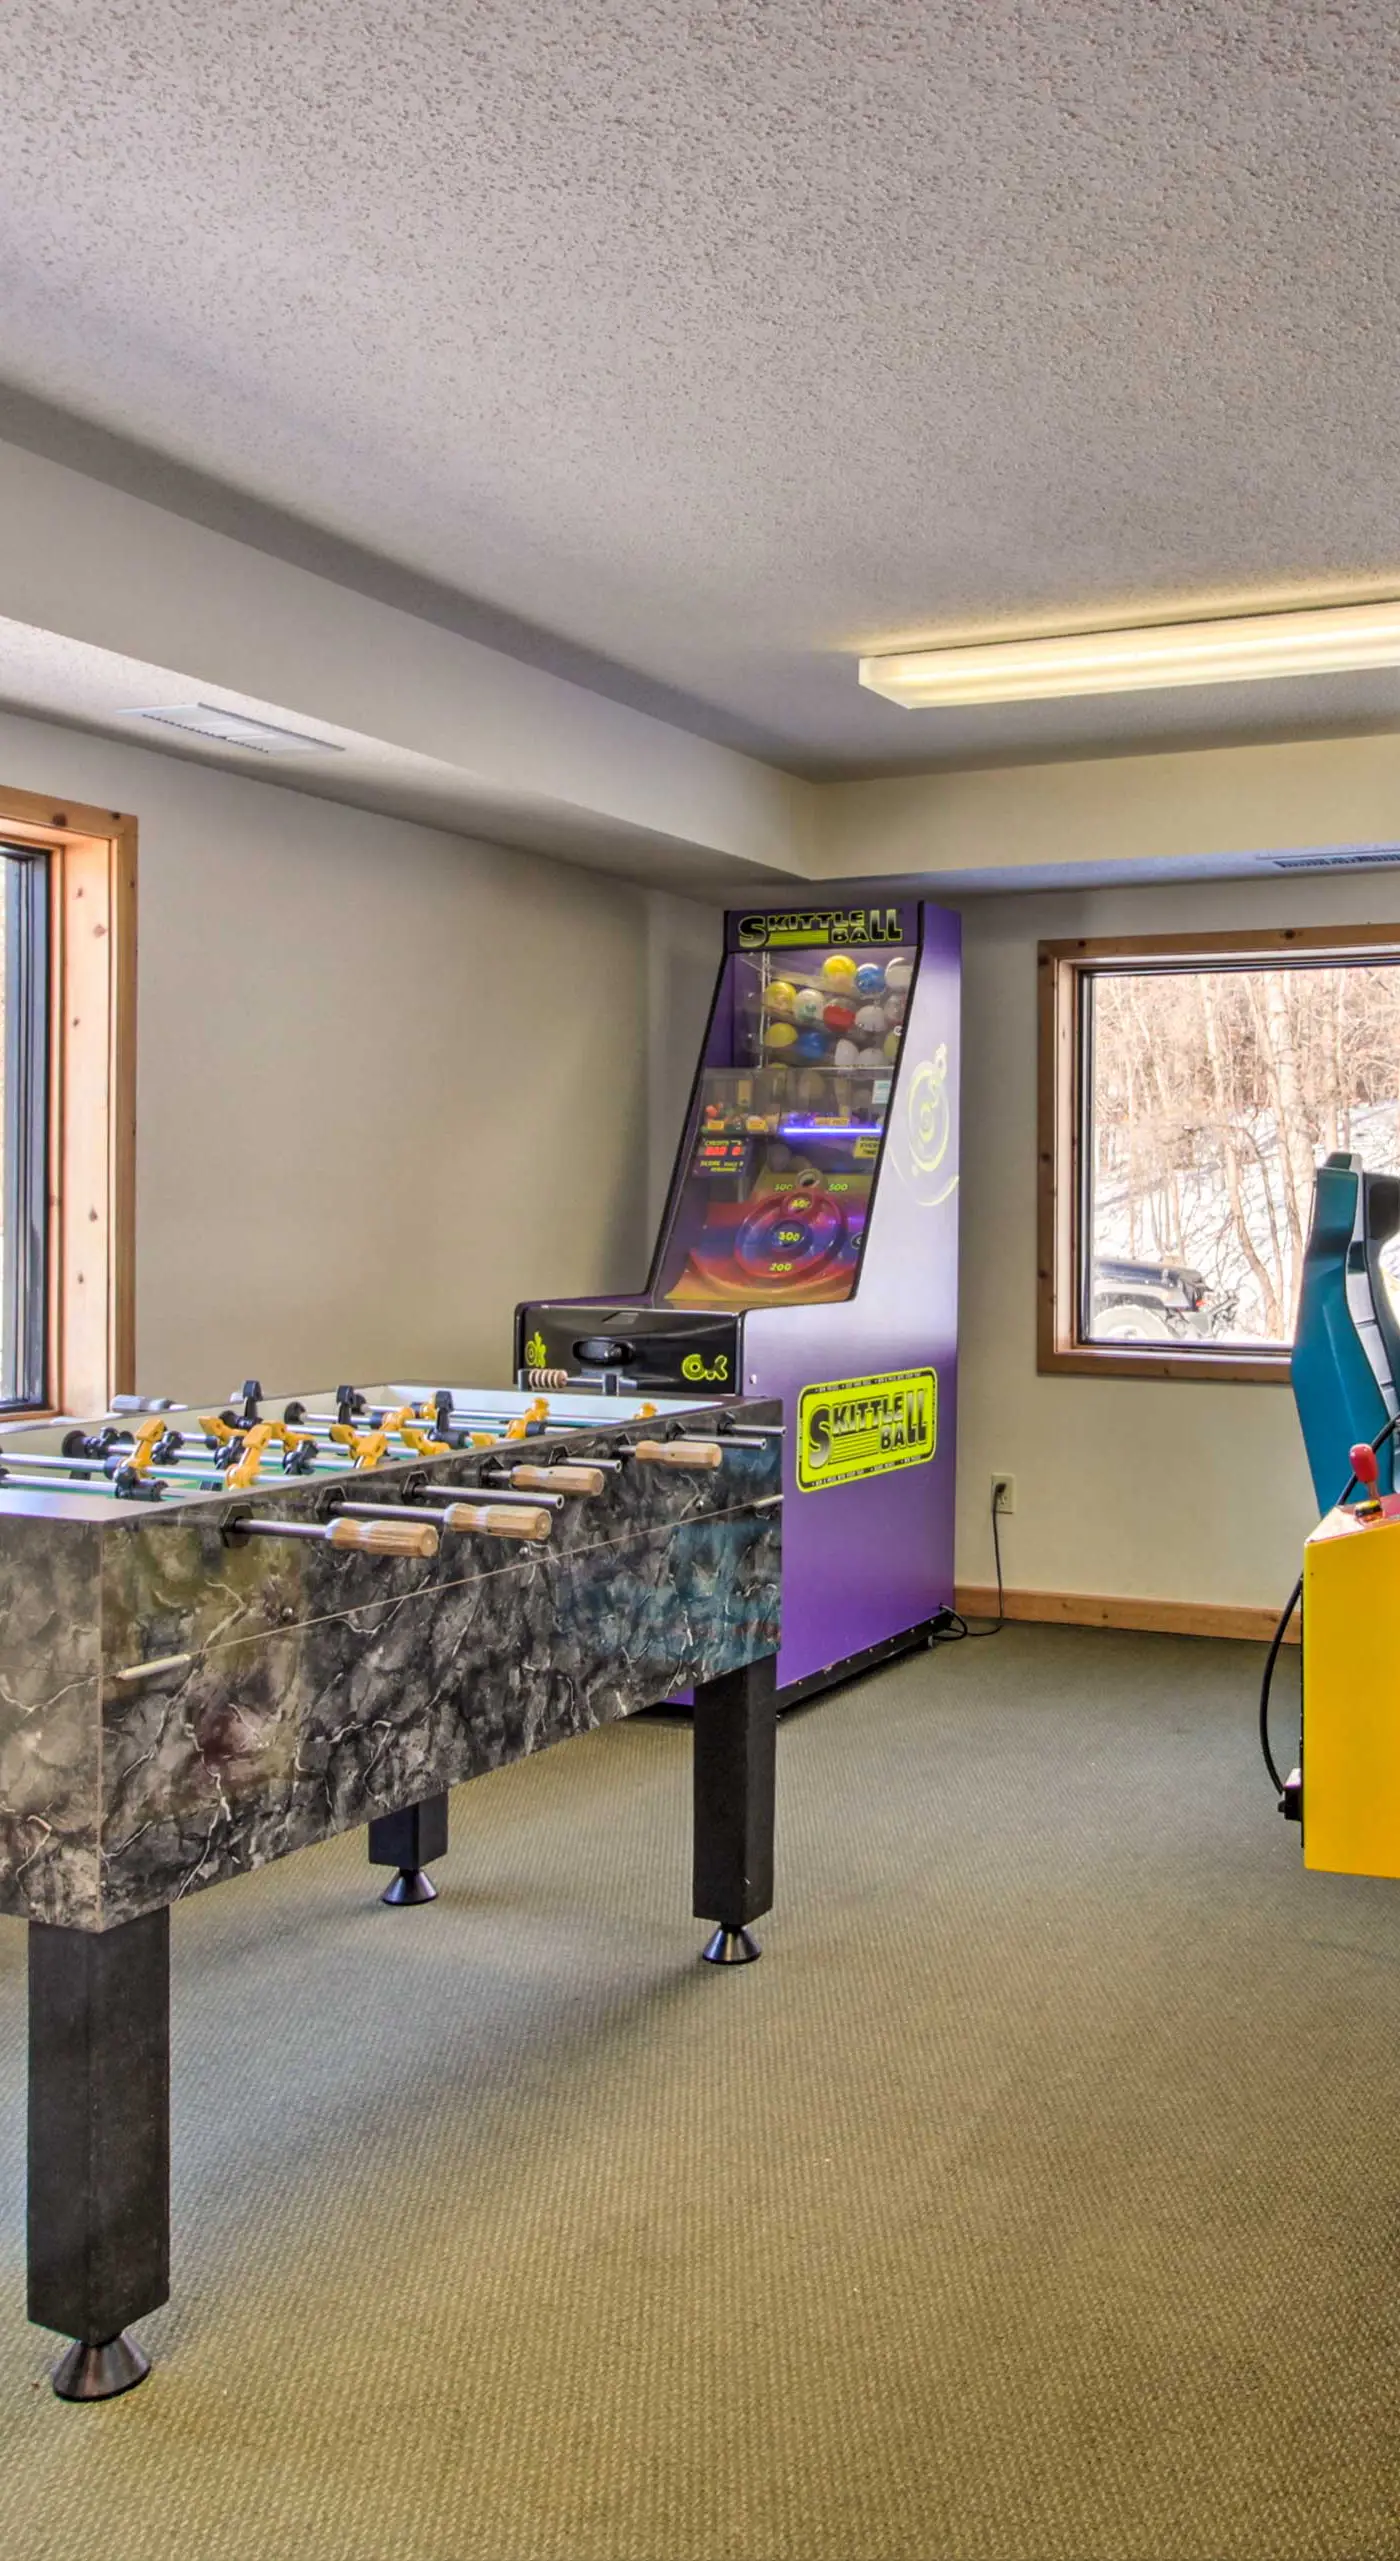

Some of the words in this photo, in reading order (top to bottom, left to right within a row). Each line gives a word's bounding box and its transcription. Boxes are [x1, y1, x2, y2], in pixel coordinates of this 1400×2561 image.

[738, 910, 865, 948] SKITTLE
[831, 908, 903, 944] BALL
[828, 1183, 848, 1192] 500
[808, 1393, 905, 1470] SKITTLE
[880, 1388, 928, 1454] BALL
